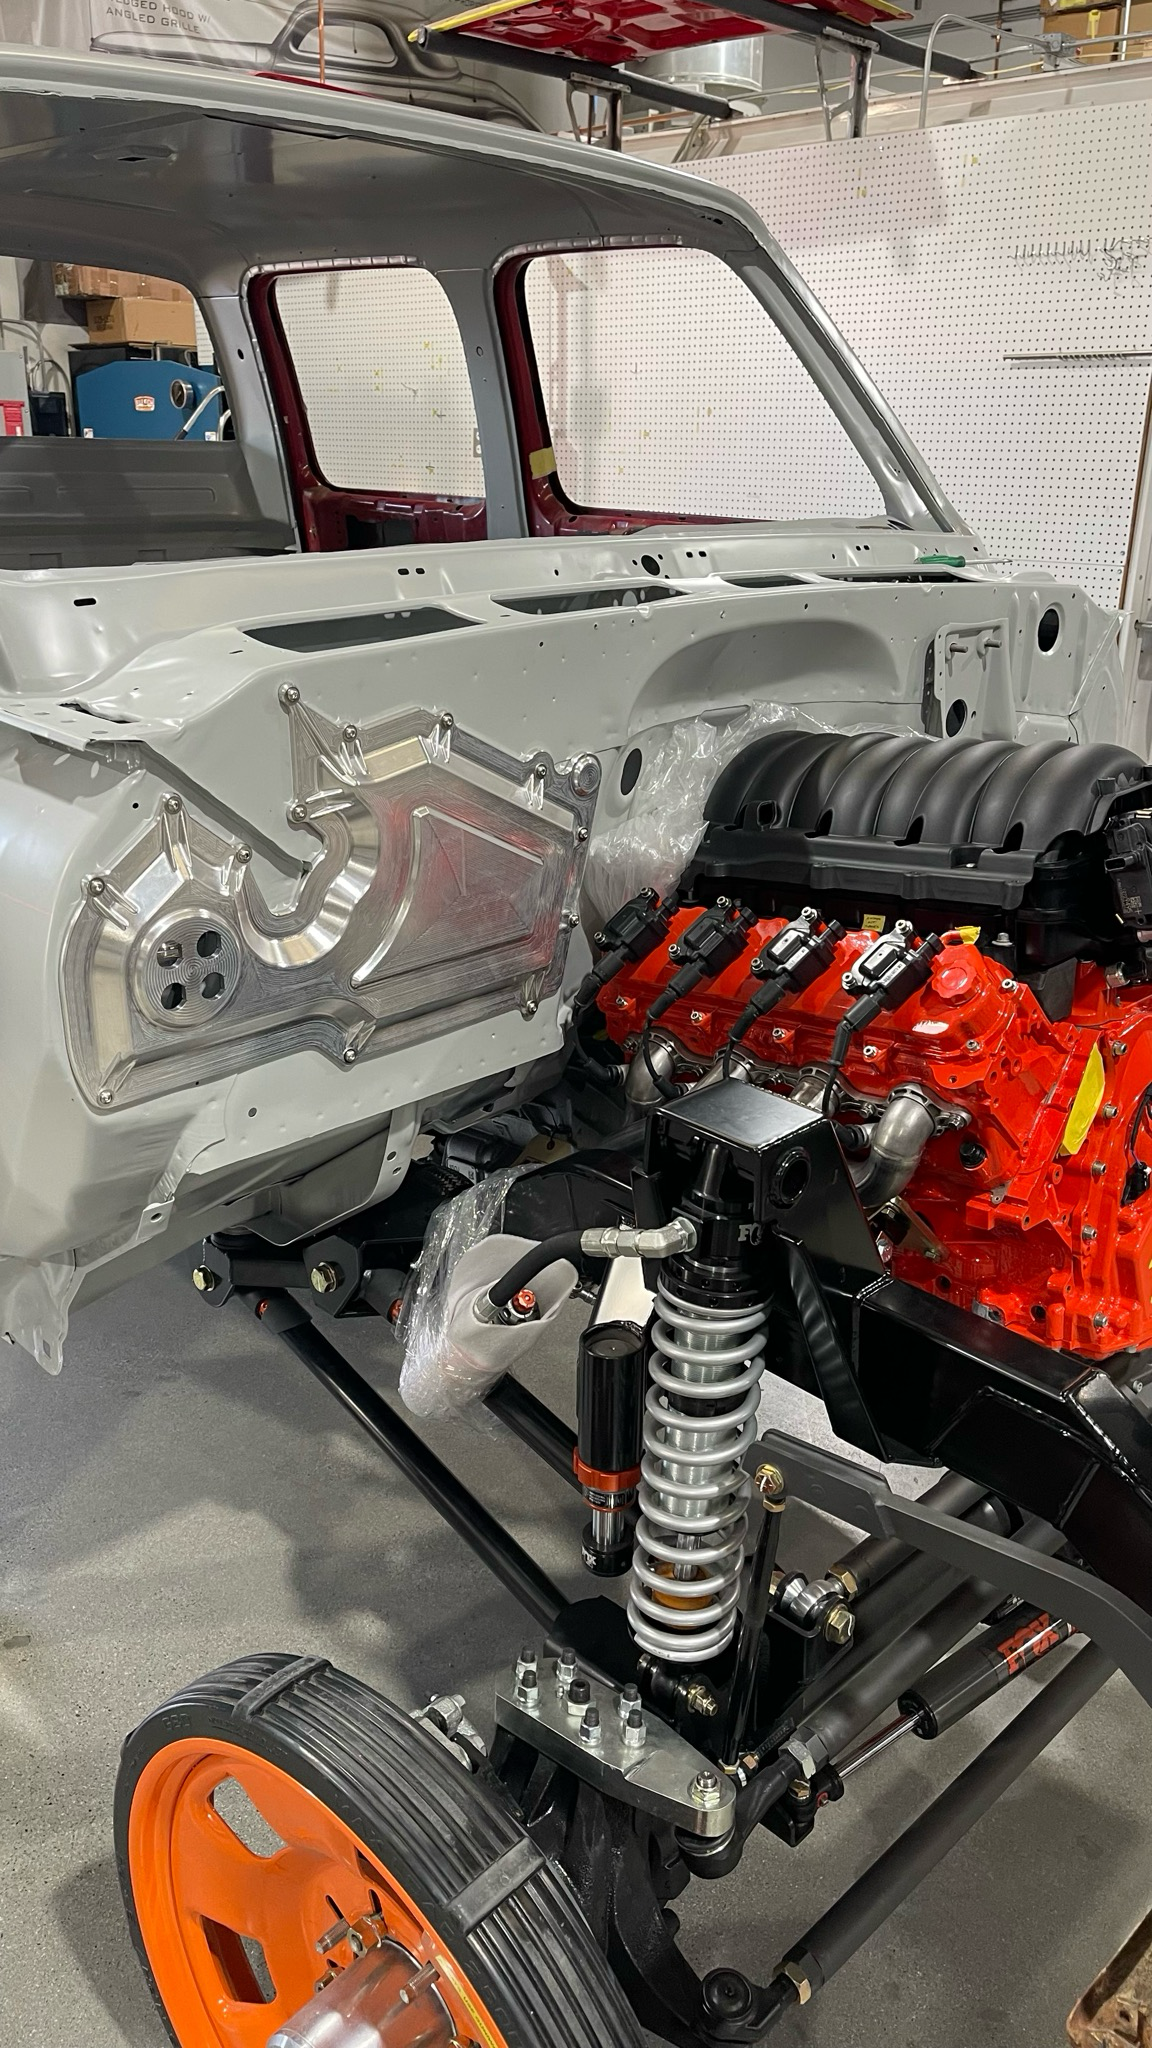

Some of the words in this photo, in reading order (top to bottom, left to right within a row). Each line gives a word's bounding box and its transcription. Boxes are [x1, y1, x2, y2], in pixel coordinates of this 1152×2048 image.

[105, 6, 156, 24] ANGLED
[160, 17, 201, 34] GRILLE
[162, 3, 195, 20] HOOD
